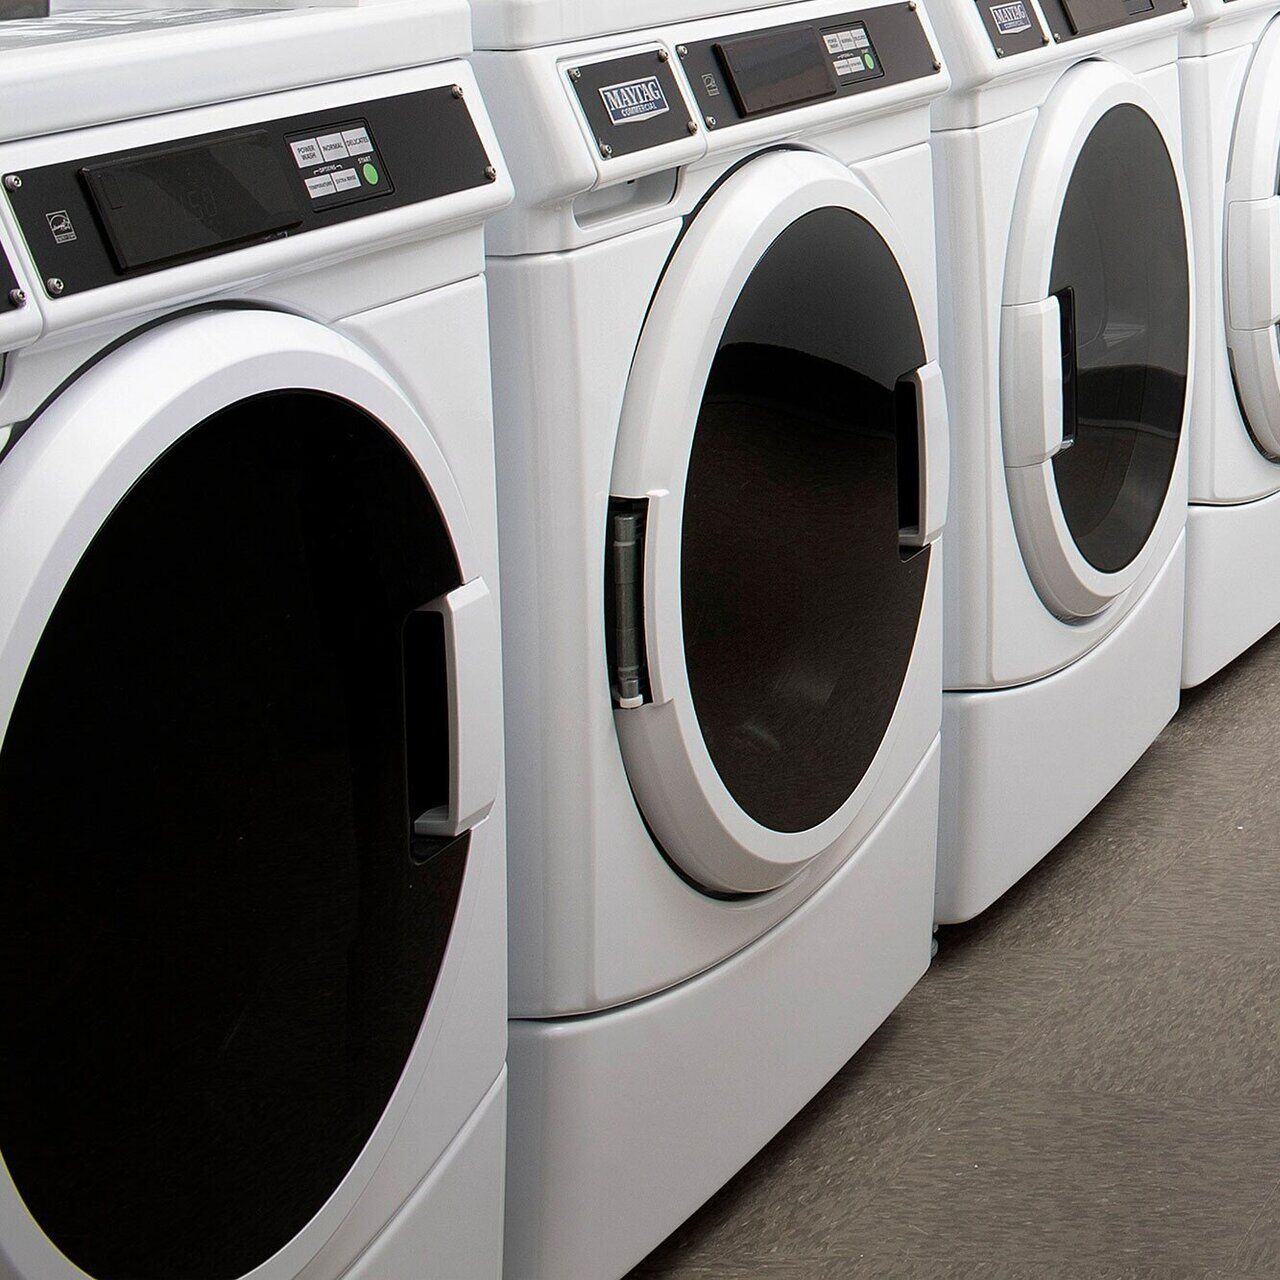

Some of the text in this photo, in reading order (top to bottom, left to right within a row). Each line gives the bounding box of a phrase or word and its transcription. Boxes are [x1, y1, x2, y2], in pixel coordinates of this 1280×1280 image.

[604, 81, 660, 110] MAYTAG
[621, 102, 657, 117] COMMERCIAL
[346, 136, 368, 147] DELICATES
[298, 145, 315, 154] POWER
[322, 142, 343, 151] NORMAL
[302, 152, 316, 160] WASH
[357, 155, 371, 164] START
